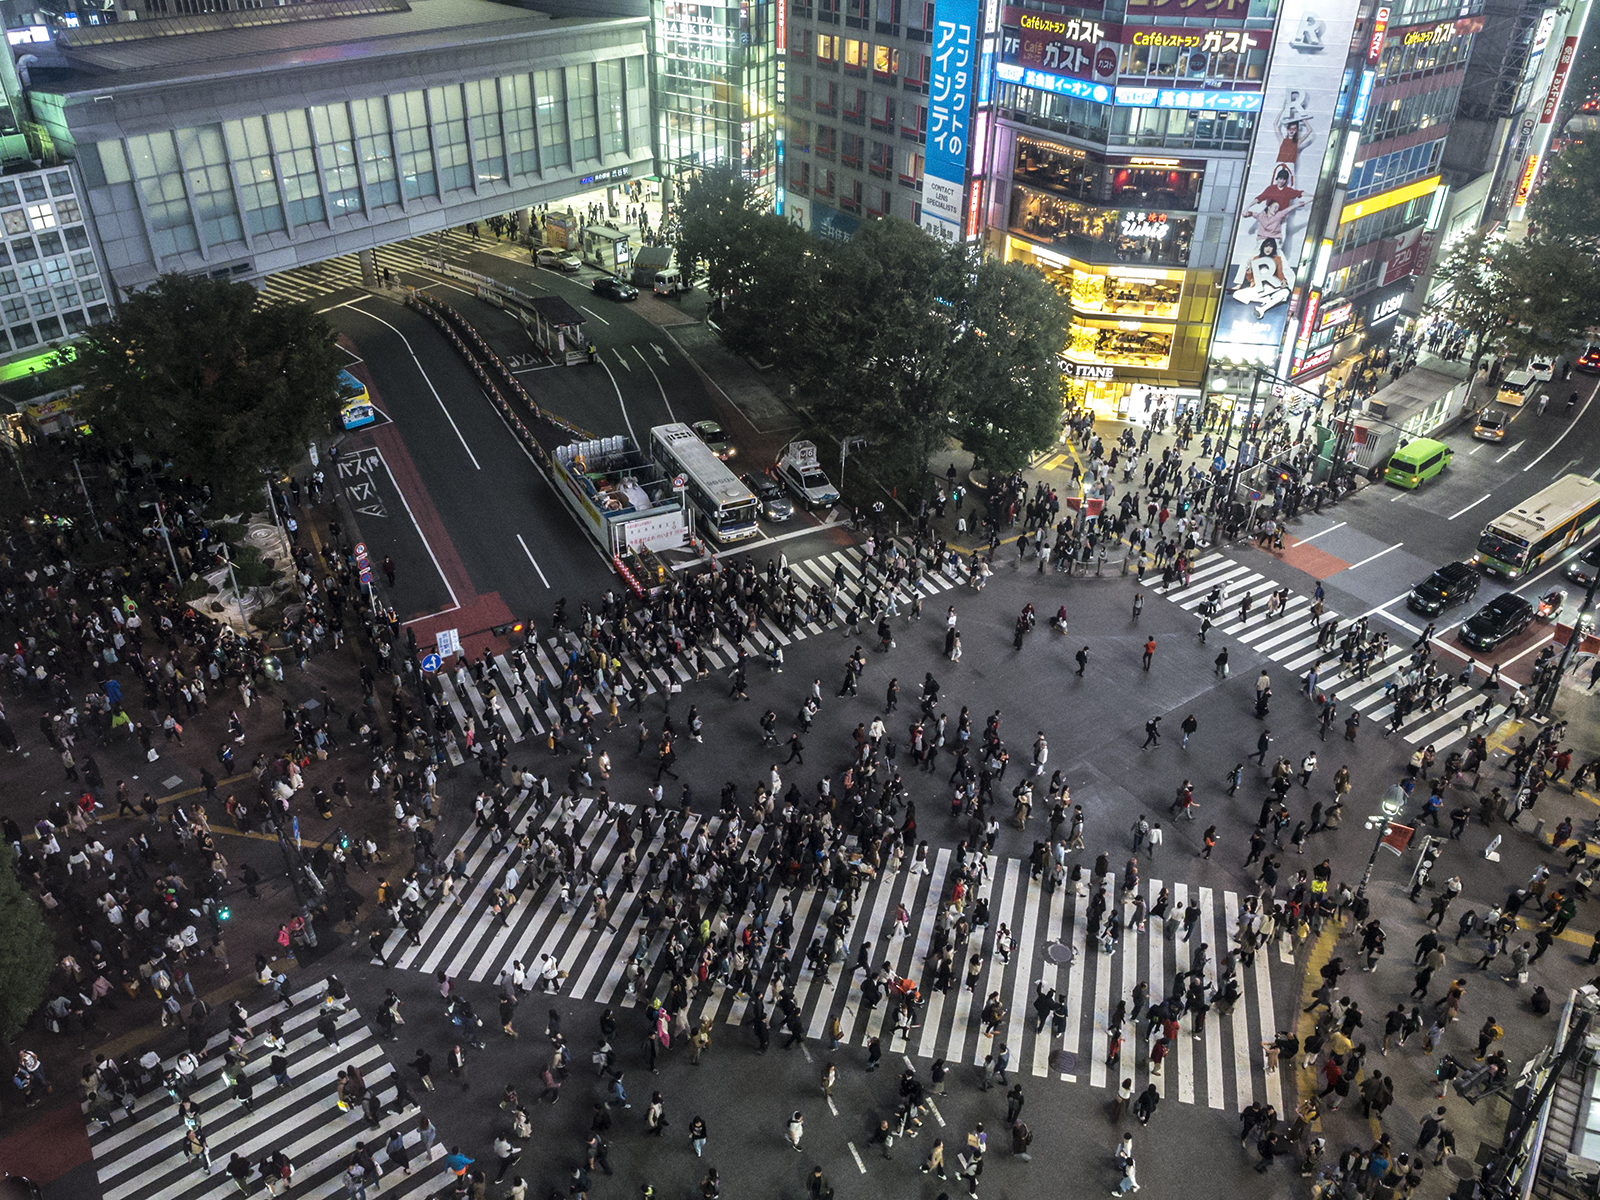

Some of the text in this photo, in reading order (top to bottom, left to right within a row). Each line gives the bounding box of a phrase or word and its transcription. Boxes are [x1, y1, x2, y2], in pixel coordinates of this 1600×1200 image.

[1066, 18, 1104, 44] ガスト
[1201, 30, 1258, 53] ガスト
[1431, 23, 1456, 44] ガスト
[1004, 36, 1020, 54] 7F
[1043, 41, 1090, 72] ガスト
[1370, 32, 1383, 59] ガスト
[932, 21, 956, 150] アイシティ
[949, 24, 970, 156] コンタクトの
[931, 182, 955, 196] CONTACT
[935, 193, 949, 202] LENS
[926, 197, 957, 213] SPECIALISTS
[1373, 293, 1405, 321] LUSH
